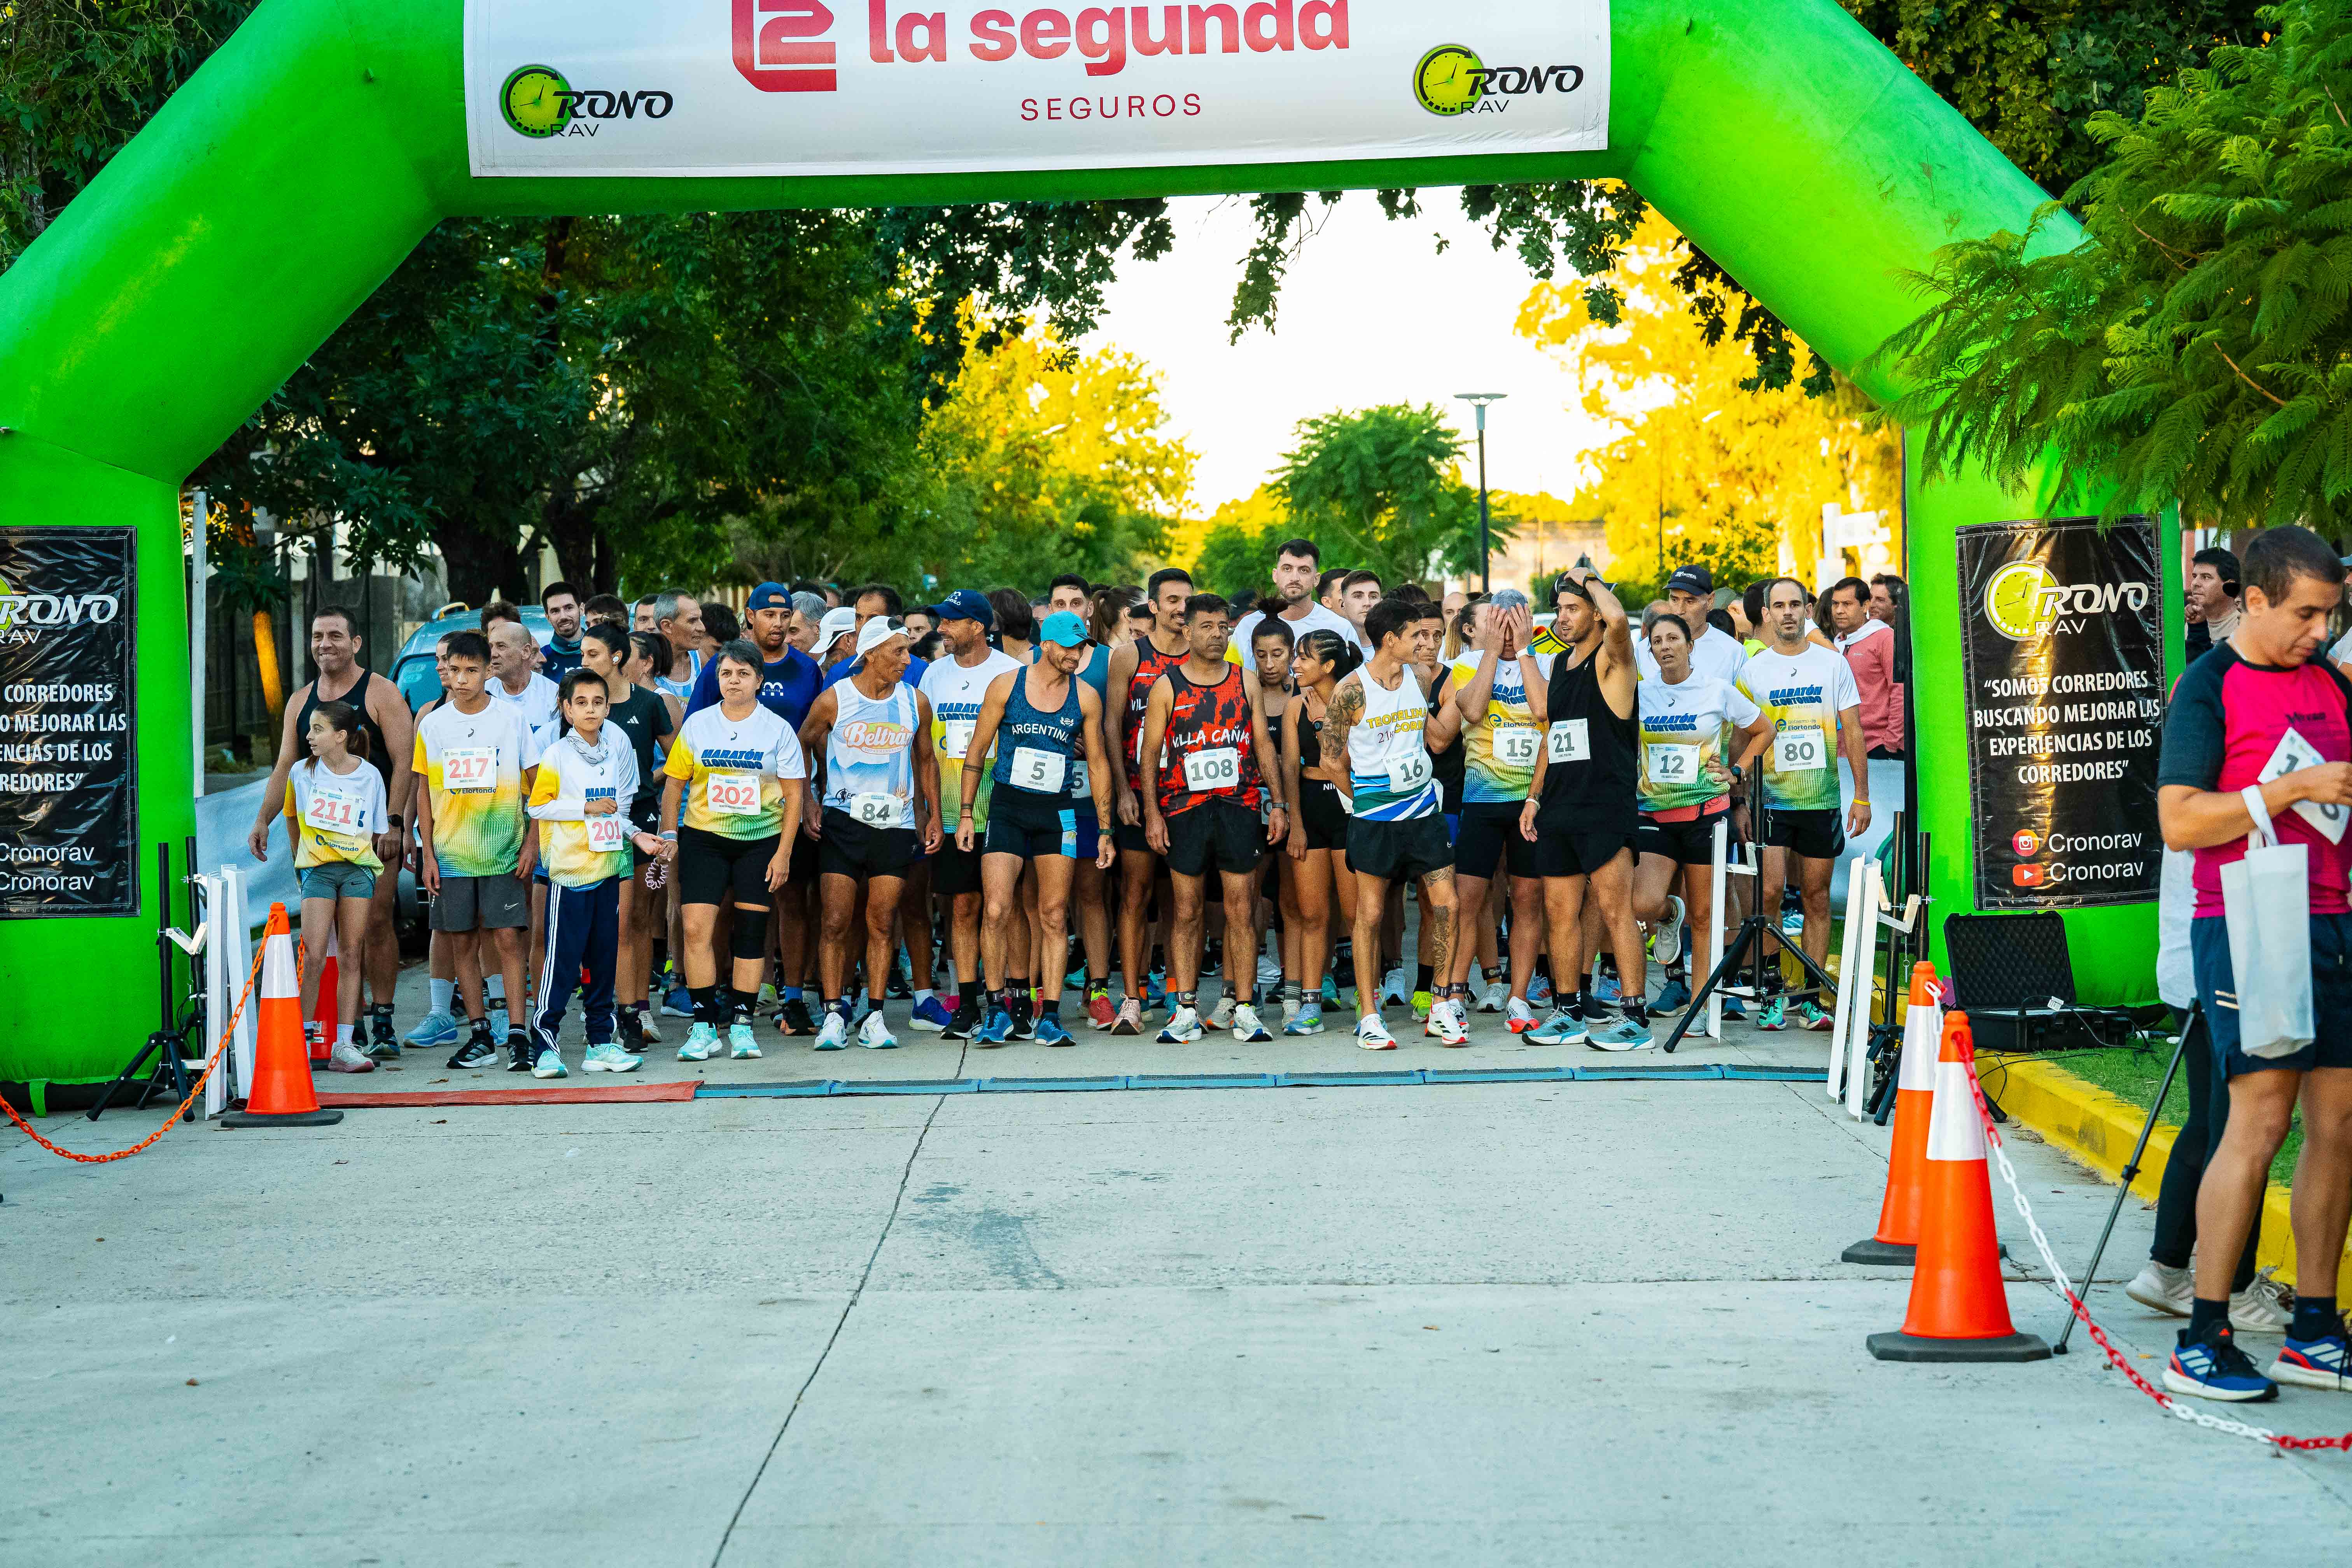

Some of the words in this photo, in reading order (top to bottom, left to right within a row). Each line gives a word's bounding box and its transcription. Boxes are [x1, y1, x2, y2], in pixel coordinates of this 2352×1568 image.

[869, 0, 947, 63] la
[969, 0, 1349, 76] segunda
[1020, 93, 1201, 121] SEGUROS
[1461, 100, 1510, 114] RAV
[551, 124, 600, 137] RAV
[2035, 619, 2087, 637] RAV
[2053, 670, 2148, 693] CORREDORES
[5, 684, 114, 702] CORREDORES
[1769, 684, 1823, 700] MARATÓN
[1770, 696, 1822, 707] ELORTONDO
[15, 714, 95, 732] MEJORAR
[100, 713, 126, 731] LAS
[1643, 713, 1698, 724] MARATÓN
[1974, 707, 2060, 728] BUSCANDO
[2064, 701, 2137, 723] MEJORAR
[2140, 698, 2160, 718] LAS
[1012, 723, 1069, 743] ARGENTINA
[1644, 723, 1697, 732] ELORTONDO
[1506, 738, 1532, 757] 15
[1553, 732, 1575, 753] 21
[1785, 742, 1814, 761] 80
[1990, 733, 2103, 756] EXPERIENCIAS
[2106, 731, 2125, 750] DE
[2128, 728, 2152, 748] LOS
[57, 744, 80, 761] DE
[84, 743, 112, 761] LOS
[701, 749, 764, 761] MARATÓN
[448, 758, 489, 778] 217
[702, 759, 763, 770] ELORTONDO
[1031, 761, 1046, 780] 5
[1190, 759, 1234, 781] 108
[1400, 759, 1423, 782] 16
[1660, 755, 1684, 774] 12
[712, 785, 755, 805] 202
[311, 798, 352, 824] 211
[862, 803, 890, 821] 84
[592, 821, 621, 841] 201
[2049, 831, 2142, 852] Cronorav
[0, 842, 94, 862] Cronorav
[0, 871, 94, 891] Cronorav
[2049, 861, 2144, 882] Cronorav
